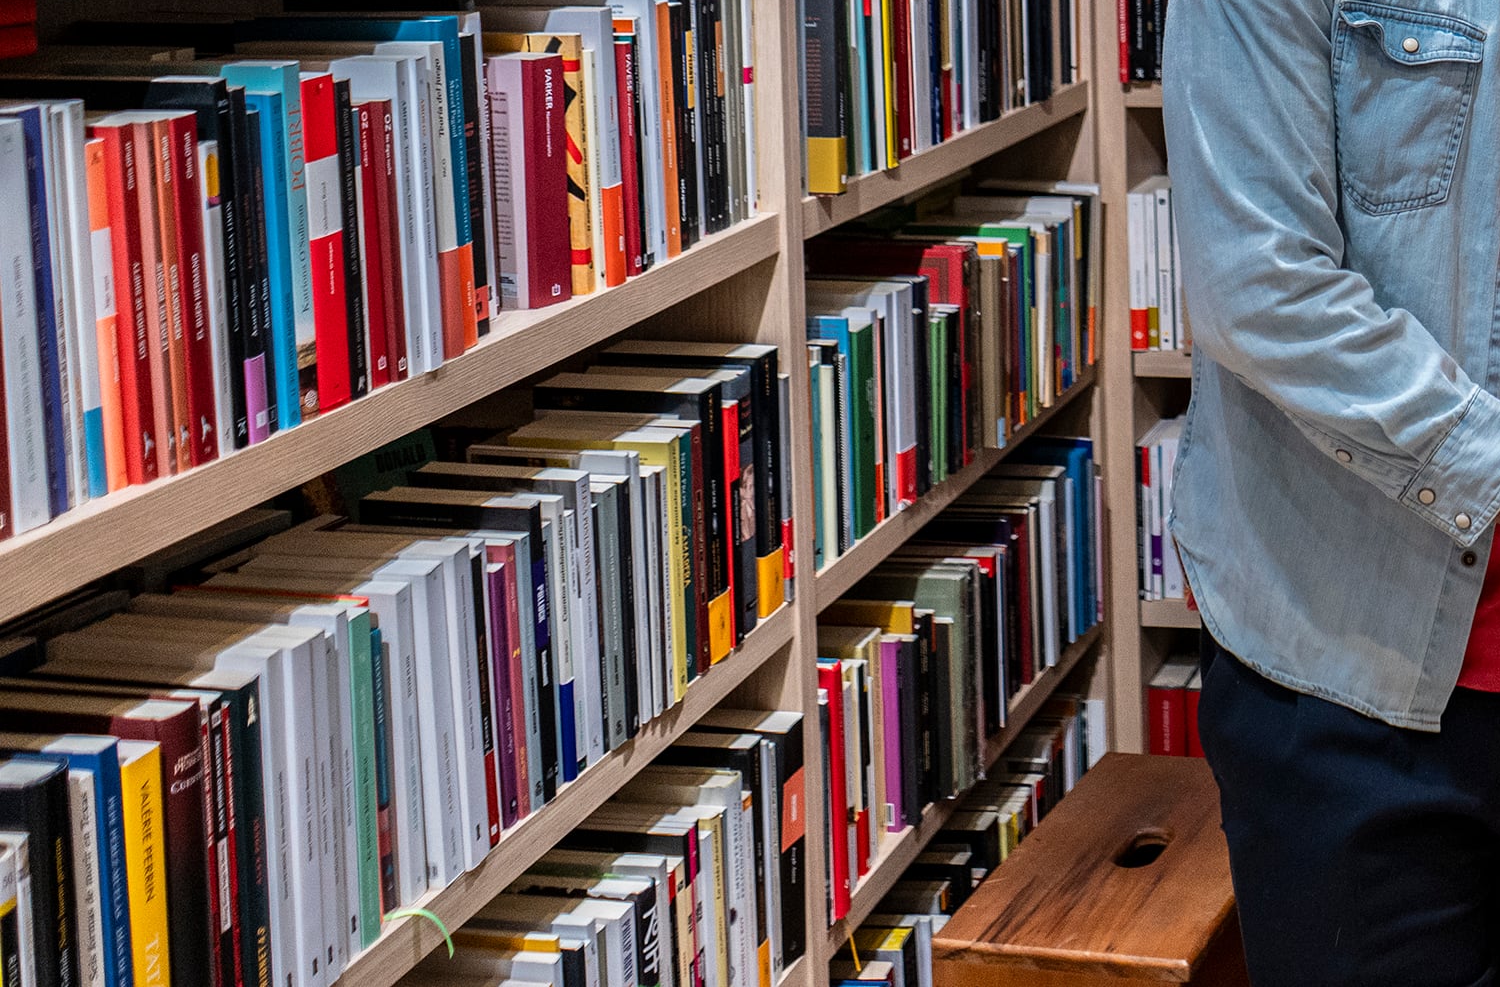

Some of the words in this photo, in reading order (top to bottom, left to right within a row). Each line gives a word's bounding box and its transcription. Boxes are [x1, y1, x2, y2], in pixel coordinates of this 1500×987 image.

[544, 68, 554, 111] PARKER
[624, 53, 633, 92] PAVESE
[448, 79, 457, 107] Marcel
[436, 106, 445, 138] Teoría
[449, 109, 459, 138] Pagnol
[286, 98, 305, 192] POBRE
[297, 204, 308, 260] O'Sullivan
[191, 252, 202, 299] HERMANO
[300, 262, 310, 313] Katriona
[194, 302, 204, 326] BUEN
[195, 329, 205, 341] EL
[79, 791, 91, 830] Texas
[139, 780, 153, 842] VALÉRIE
[84, 834, 92, 848] en
[82, 853, 94, 885] morir
[143, 845, 157, 904] PERRIN
[84, 890, 95, 905] de
[85, 909, 97, 952] formas
[86, 955, 99, 982] Seis
